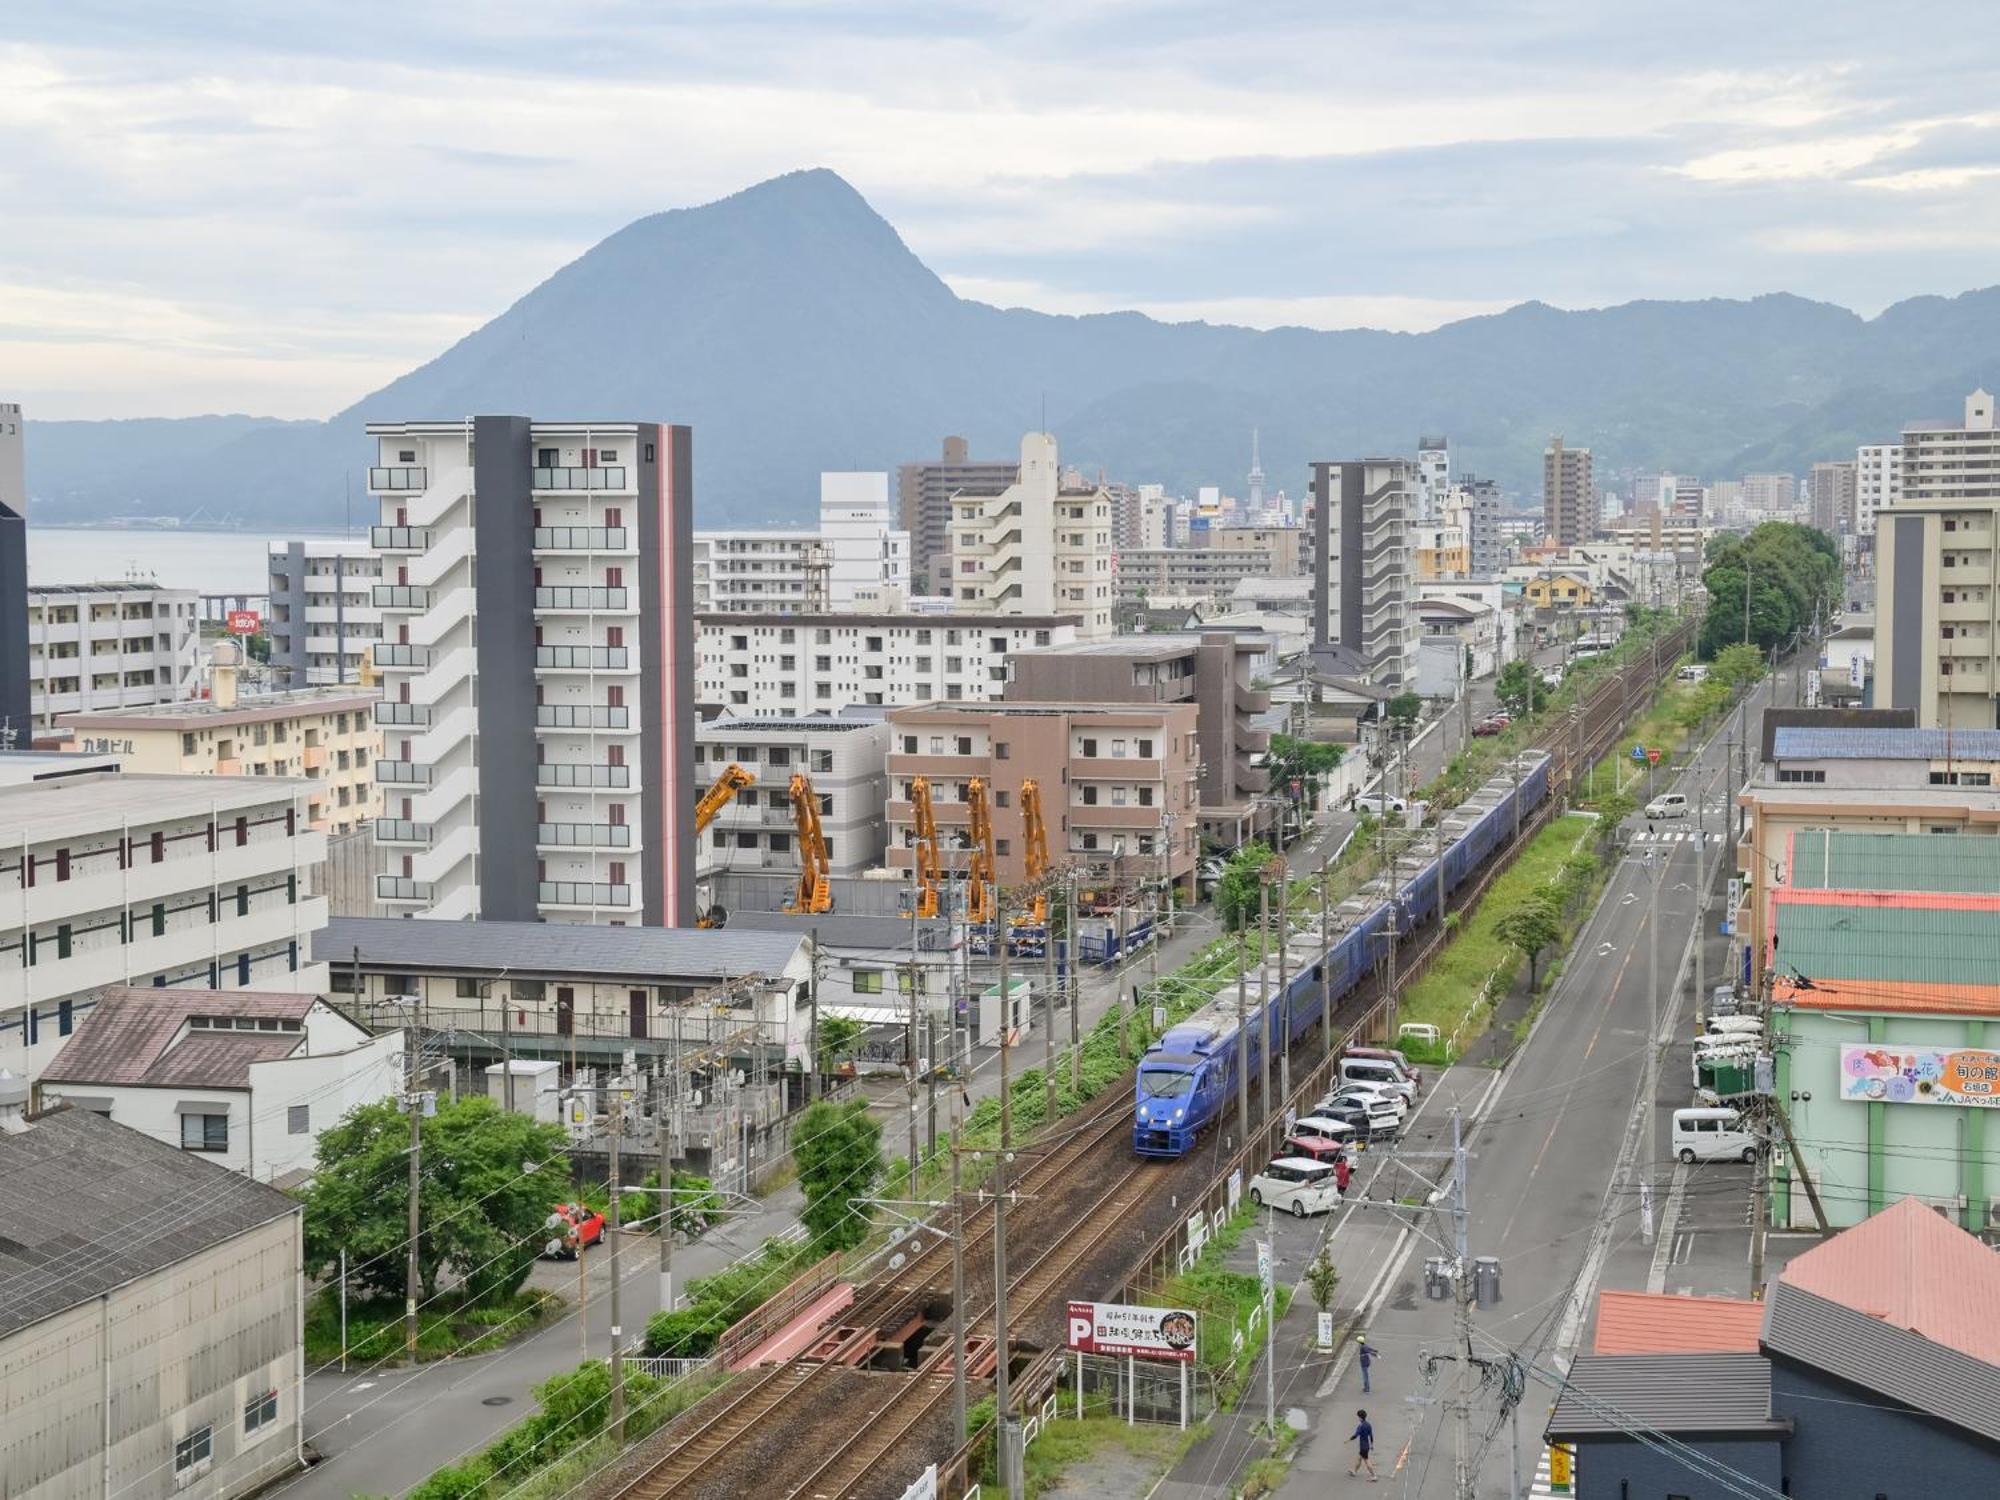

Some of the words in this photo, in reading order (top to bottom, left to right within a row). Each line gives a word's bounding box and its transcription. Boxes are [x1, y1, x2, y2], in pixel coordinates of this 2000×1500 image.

[1920, 1062, 1934, 1076] 花
[1957, 1064, 1998, 1081] 旬の館
[1070, 1318, 1091, 1346] P
